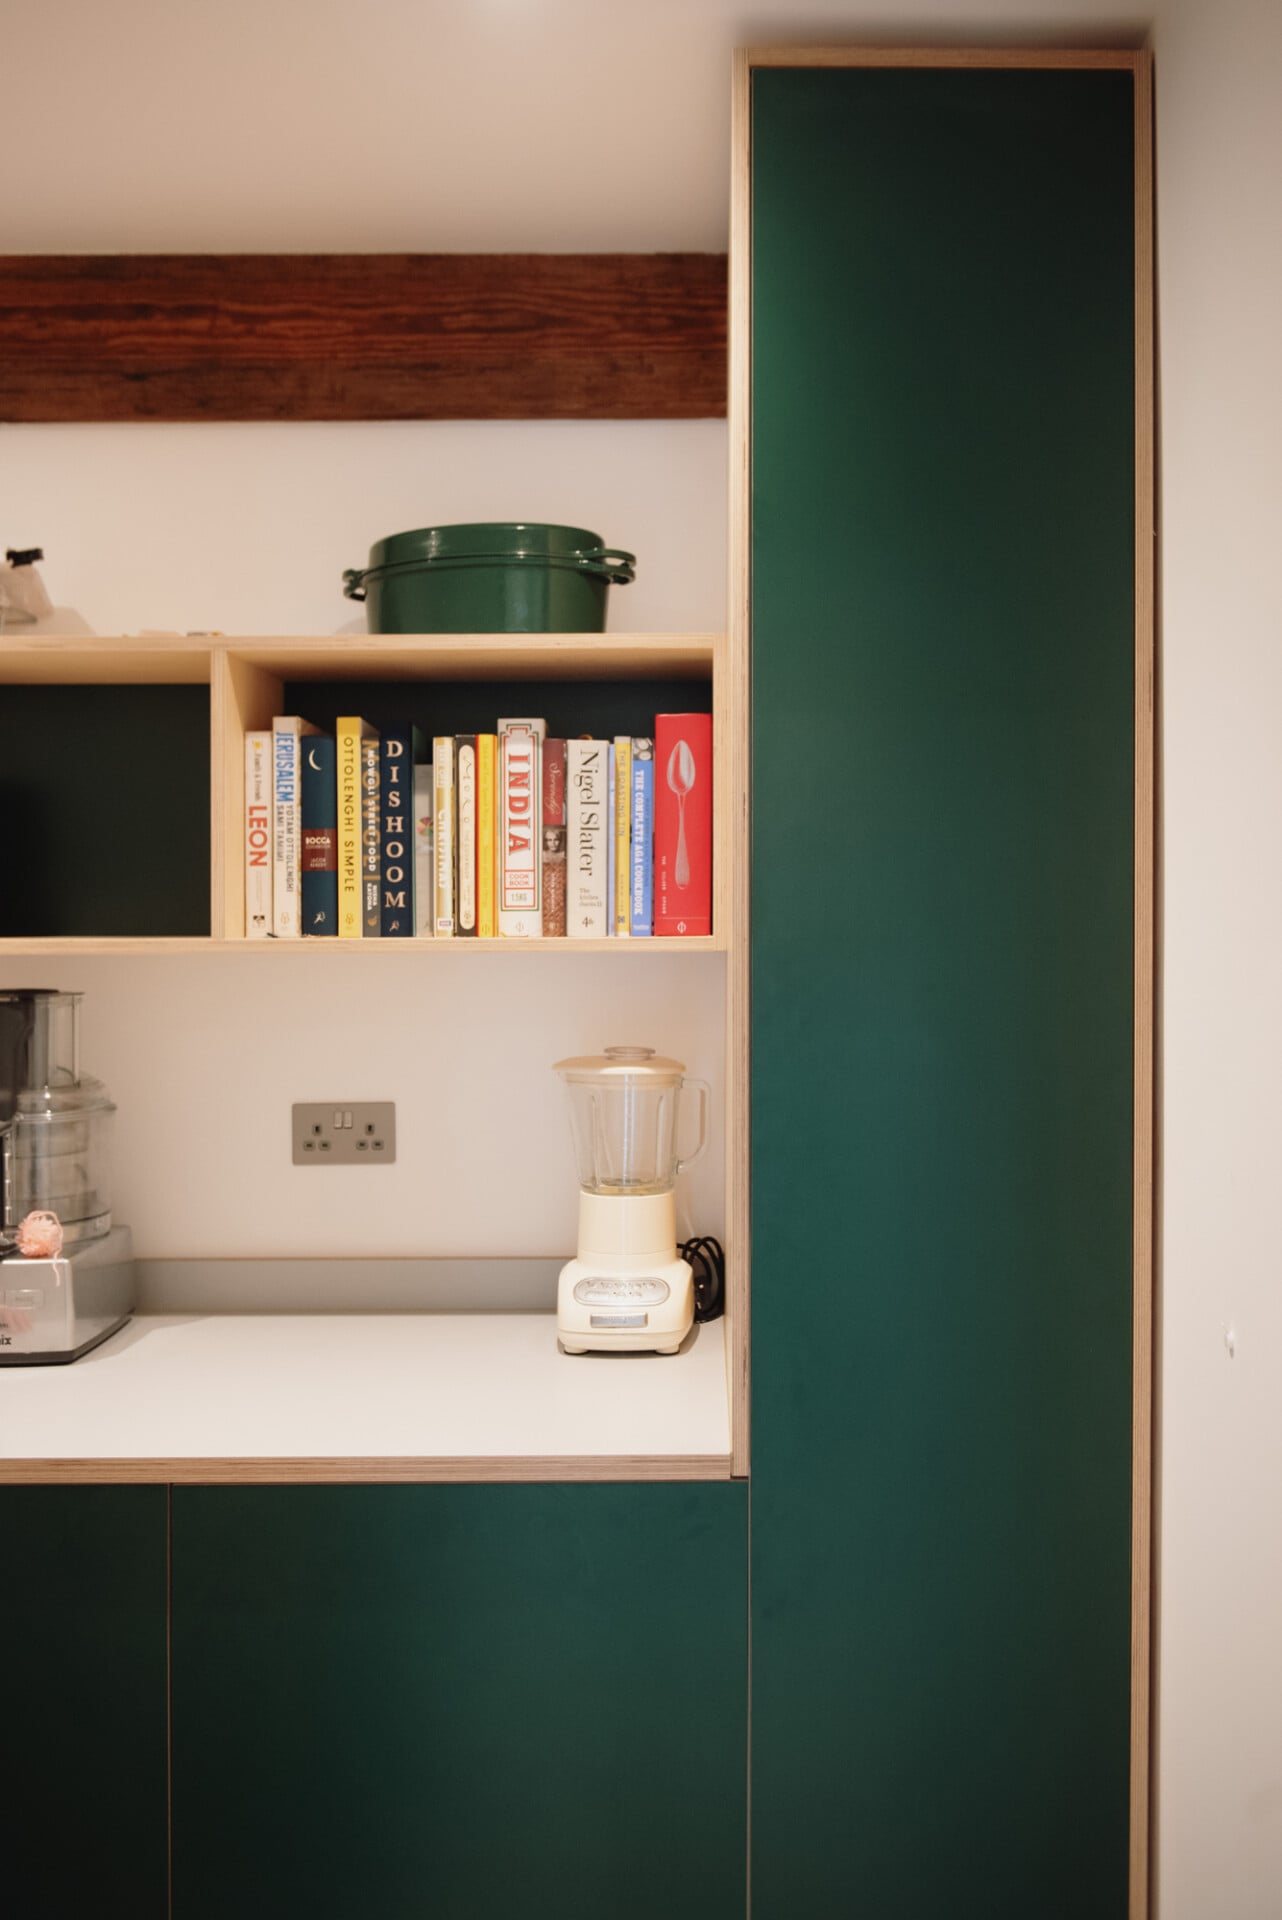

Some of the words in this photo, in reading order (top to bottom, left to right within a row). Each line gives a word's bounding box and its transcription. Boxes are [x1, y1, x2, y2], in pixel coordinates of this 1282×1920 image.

[275, 732, 294, 802] JERUSALEM
[344, 737, 354, 832] OTTOLENGHI
[367, 749, 376, 795] MOWGLI
[573, 749, 600, 805] Nigel
[635, 770, 644, 790] THE
[276, 805, 284, 827] SAMI
[286, 805, 294, 834] YOTAM
[367, 799, 376, 836] STREET
[385, 740, 406, 908] DISHOOM
[508, 754, 531, 856] INDIA
[635, 792, 644, 842] COMPLETE
[248, 805, 268, 867] LEON
[276, 830, 284, 862] TAMIMI
[305, 836, 331, 845] BOCCA
[367, 841, 376, 872] FOOD
[579, 811, 600, 876] Slater
[634, 845, 644, 863] AGA
[286, 837, 294, 893] OTTOLENGHI
[344, 840, 354, 892] SIMPLE
[634, 864, 643, 915] COOKBOOK
[0, 1334, 12, 1346] ix
